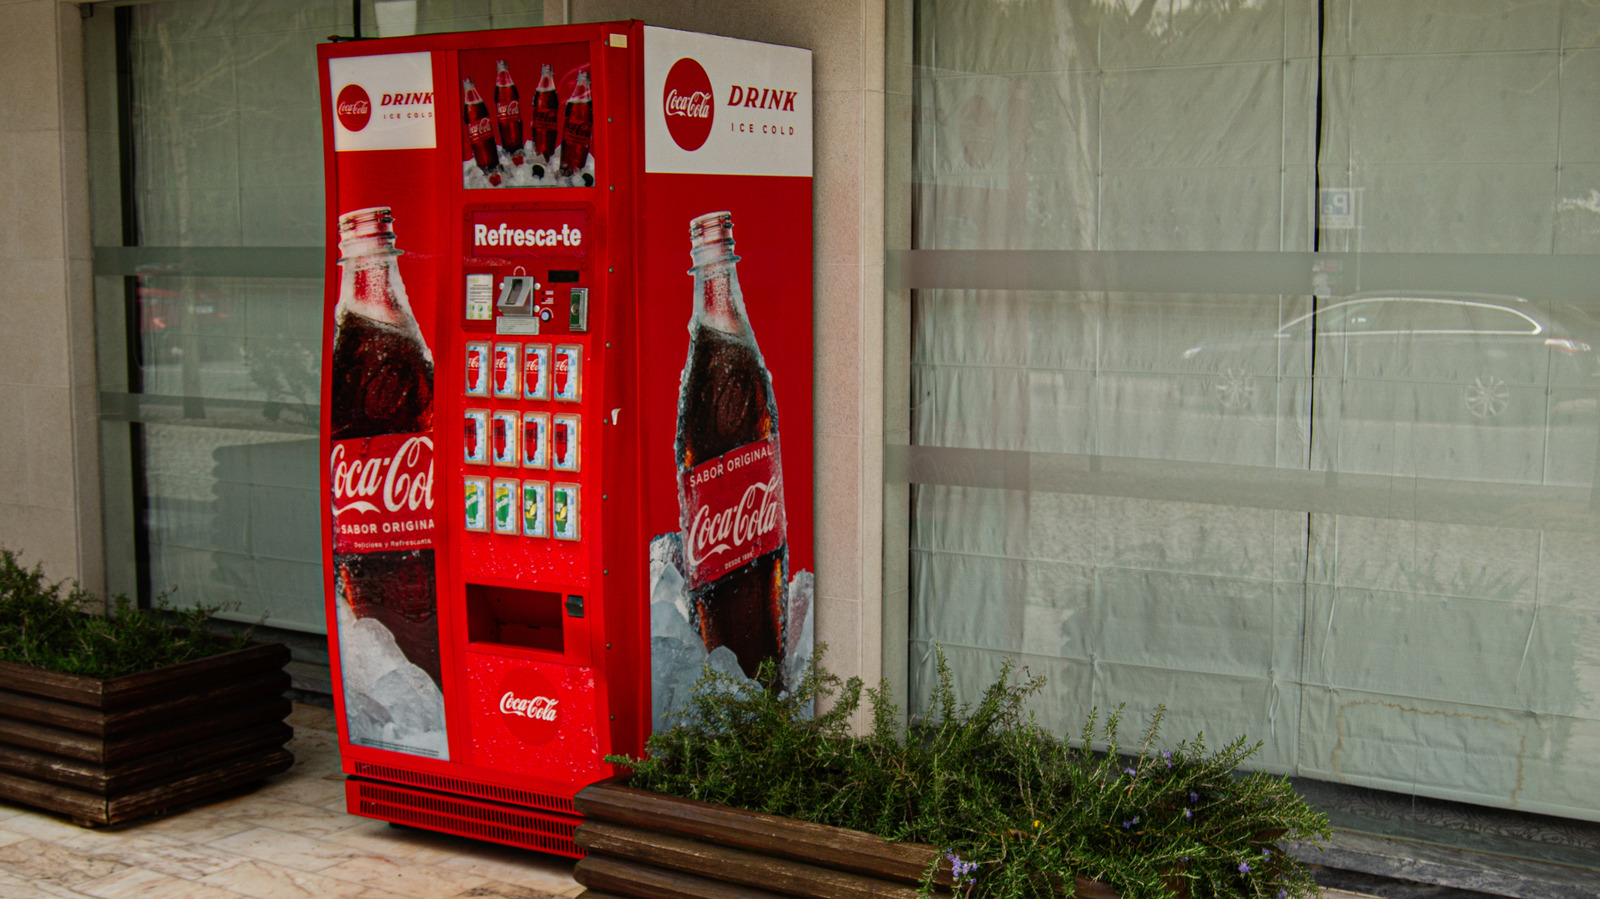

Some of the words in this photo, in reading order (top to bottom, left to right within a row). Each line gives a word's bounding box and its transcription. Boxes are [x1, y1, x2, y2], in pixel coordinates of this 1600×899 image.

[338, 100, 368, 114] Coca-Cola
[381, 92, 434, 106] DRINK
[665, 88, 712, 119] Coca-Cola
[727, 84, 798, 112] DRINK
[731, 122, 754, 133] ICE
[762, 124, 795, 136] COLD
[474, 223, 582, 247] Refresca-te
[689, 463, 724, 488] SABOR
[726, 445, 773, 472] ORIGINAL
[341, 523, 378, 534] SABOR
[688, 475, 780, 565] Coca-Cola
[499, 691, 559, 722] Coca-Cola
